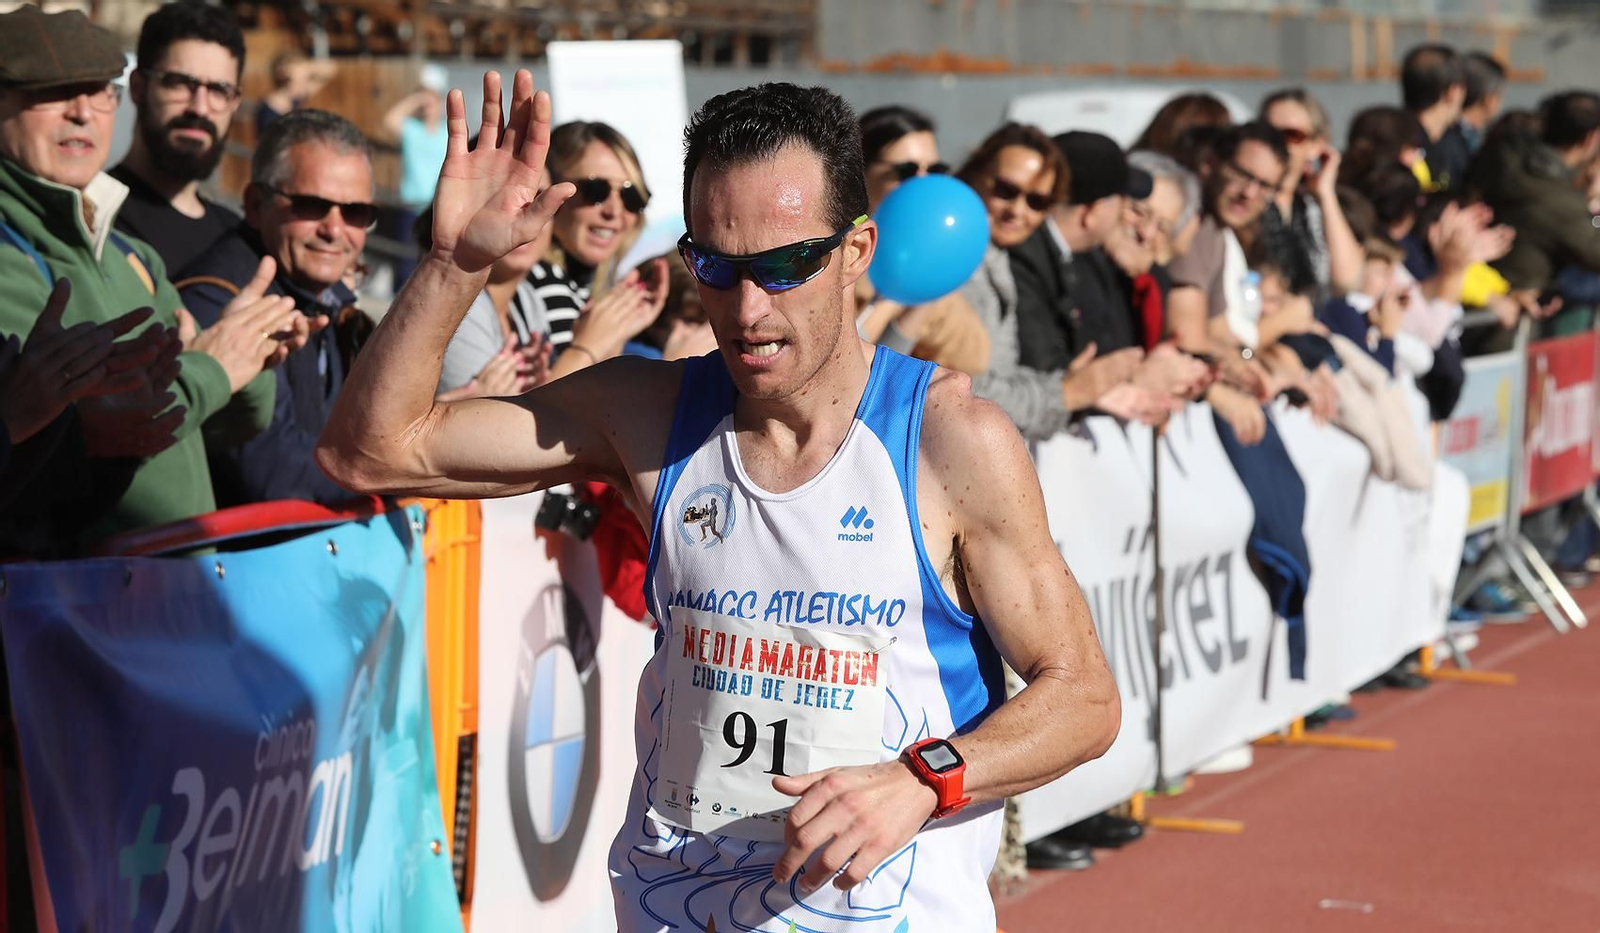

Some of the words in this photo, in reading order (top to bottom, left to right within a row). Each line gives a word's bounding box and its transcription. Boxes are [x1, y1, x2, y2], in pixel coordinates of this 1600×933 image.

[837, 532, 873, 542] mobel
[764, 589, 906, 627] ATLETISMO
[692, 664, 753, 697] CIUDAD
[761, 678, 784, 702] DE
[793, 682, 855, 711] JEREZ
[720, 711, 790, 777] 91
